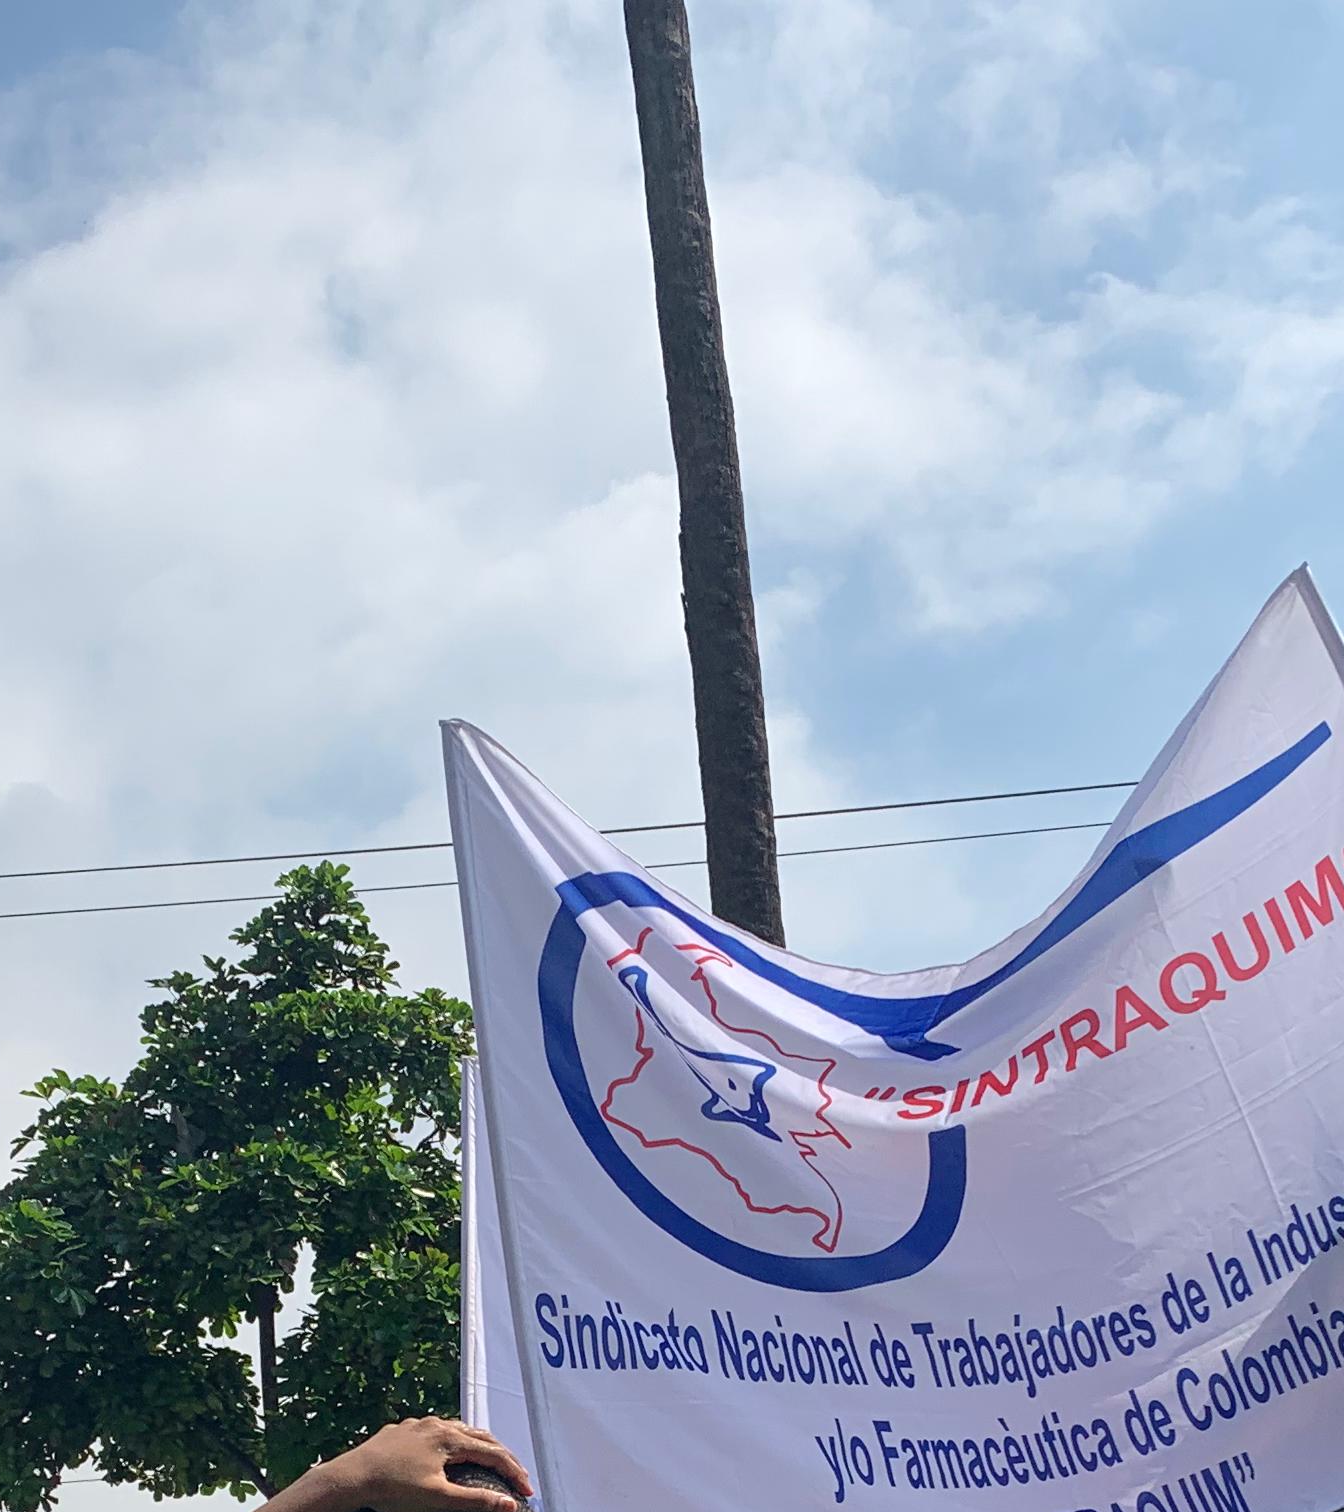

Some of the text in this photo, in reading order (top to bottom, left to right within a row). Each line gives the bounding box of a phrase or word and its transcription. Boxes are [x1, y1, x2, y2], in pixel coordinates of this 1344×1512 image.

[535, 1292, 710, 1371] Sindicato
[710, 1309, 869, 1387] Nacional
[869, 1323, 915, 1389] de
[911, 1304, 1157, 1398] Trabajadores
[1161, 1272, 1210, 1335] de
[1207, 1252, 1252, 1309] la
[1123, 1389, 1177, 1457] de
